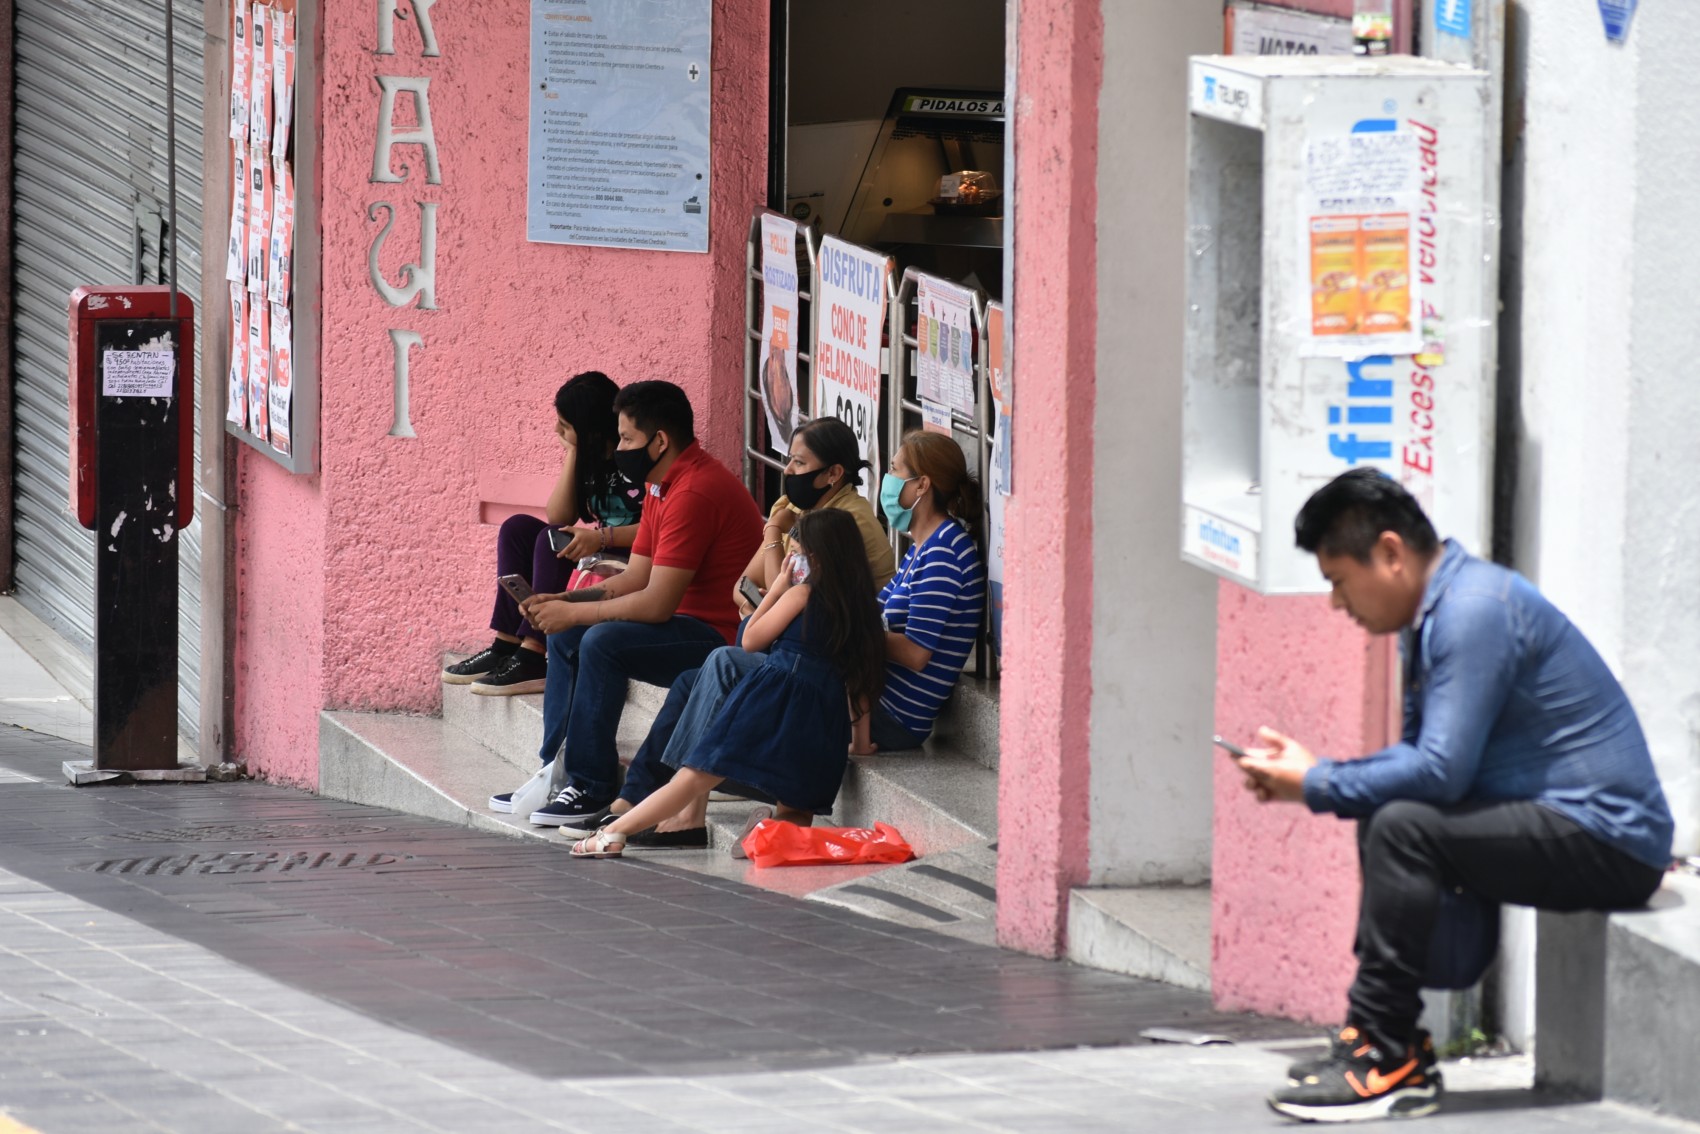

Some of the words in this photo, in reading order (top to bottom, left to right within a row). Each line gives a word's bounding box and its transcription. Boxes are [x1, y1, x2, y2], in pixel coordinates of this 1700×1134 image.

[919, 100, 989, 112] PIDALOS
[822, 246, 880, 304] DISFRUTA
[832, 304, 855, 346] CONO
[858, 314, 867, 350] DE
[819, 341, 853, 388] HELADO
[854, 357, 877, 402] SUAVE
